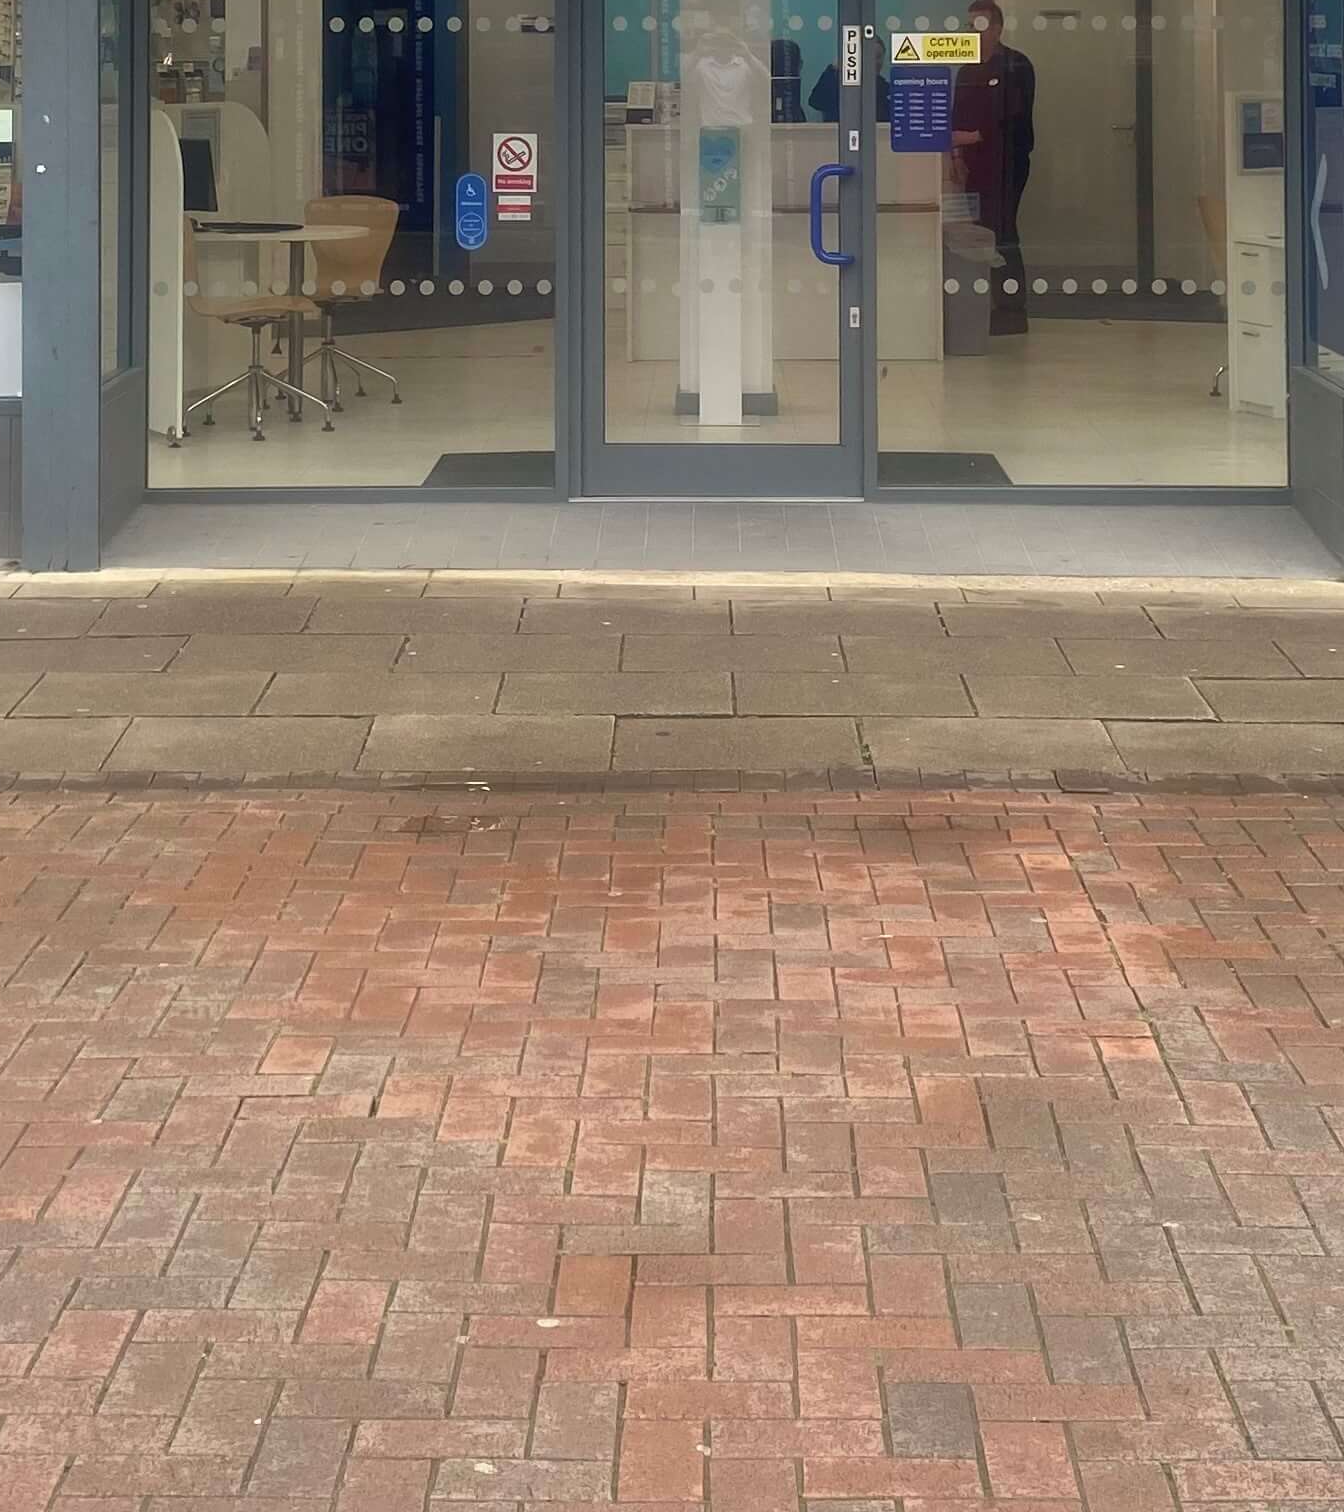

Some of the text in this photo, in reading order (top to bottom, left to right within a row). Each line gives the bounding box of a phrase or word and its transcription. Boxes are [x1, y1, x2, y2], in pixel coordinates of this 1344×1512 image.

[929, 37, 971, 47] CCTV in
[846, 30, 858, 81] PUSH
[926, 48, 975, 59] operation
